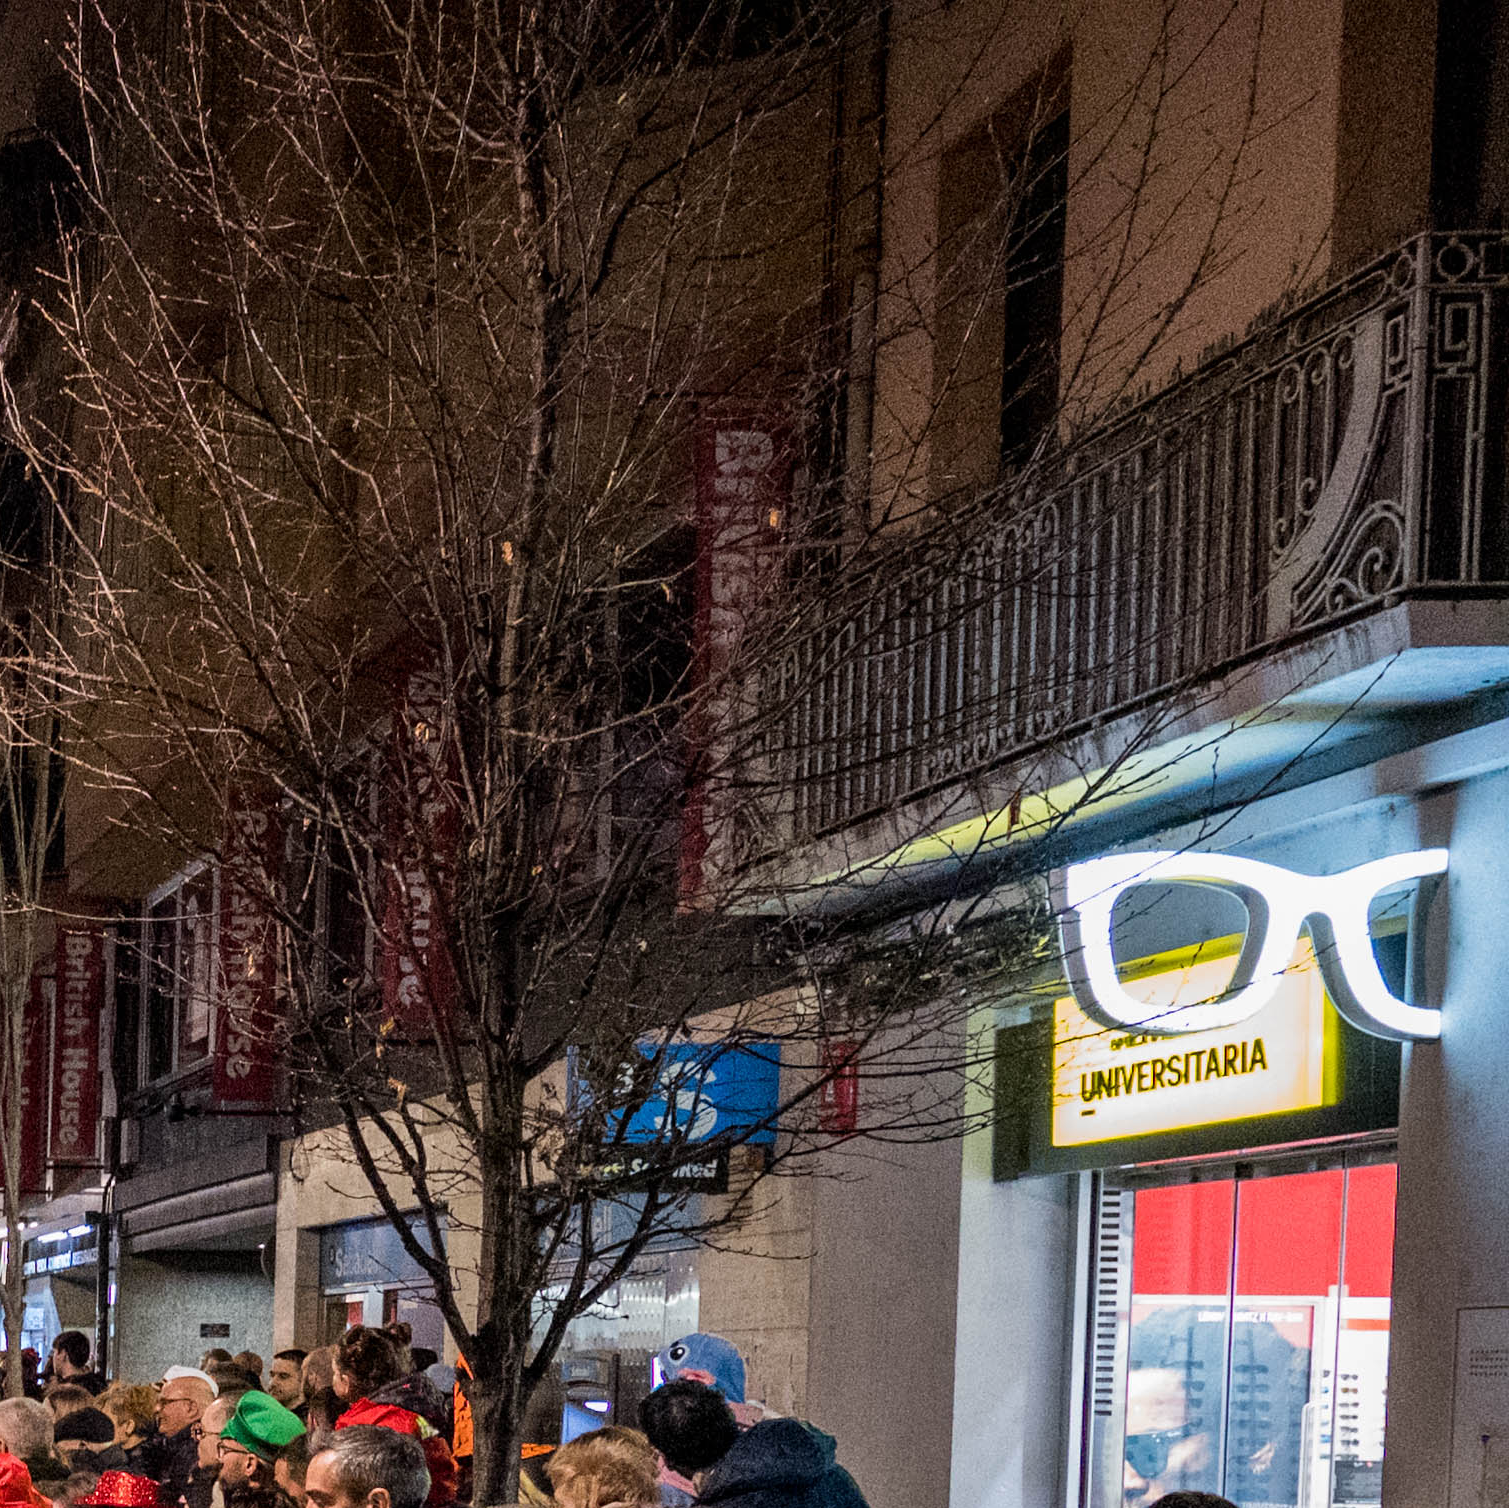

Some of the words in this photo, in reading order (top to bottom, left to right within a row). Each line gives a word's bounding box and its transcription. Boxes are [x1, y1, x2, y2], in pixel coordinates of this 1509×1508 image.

[64, 934, 95, 1037] British
[59, 1046, 90, 1146] House
[1080, 1037, 1268, 1102] UNIVERSITARIA
